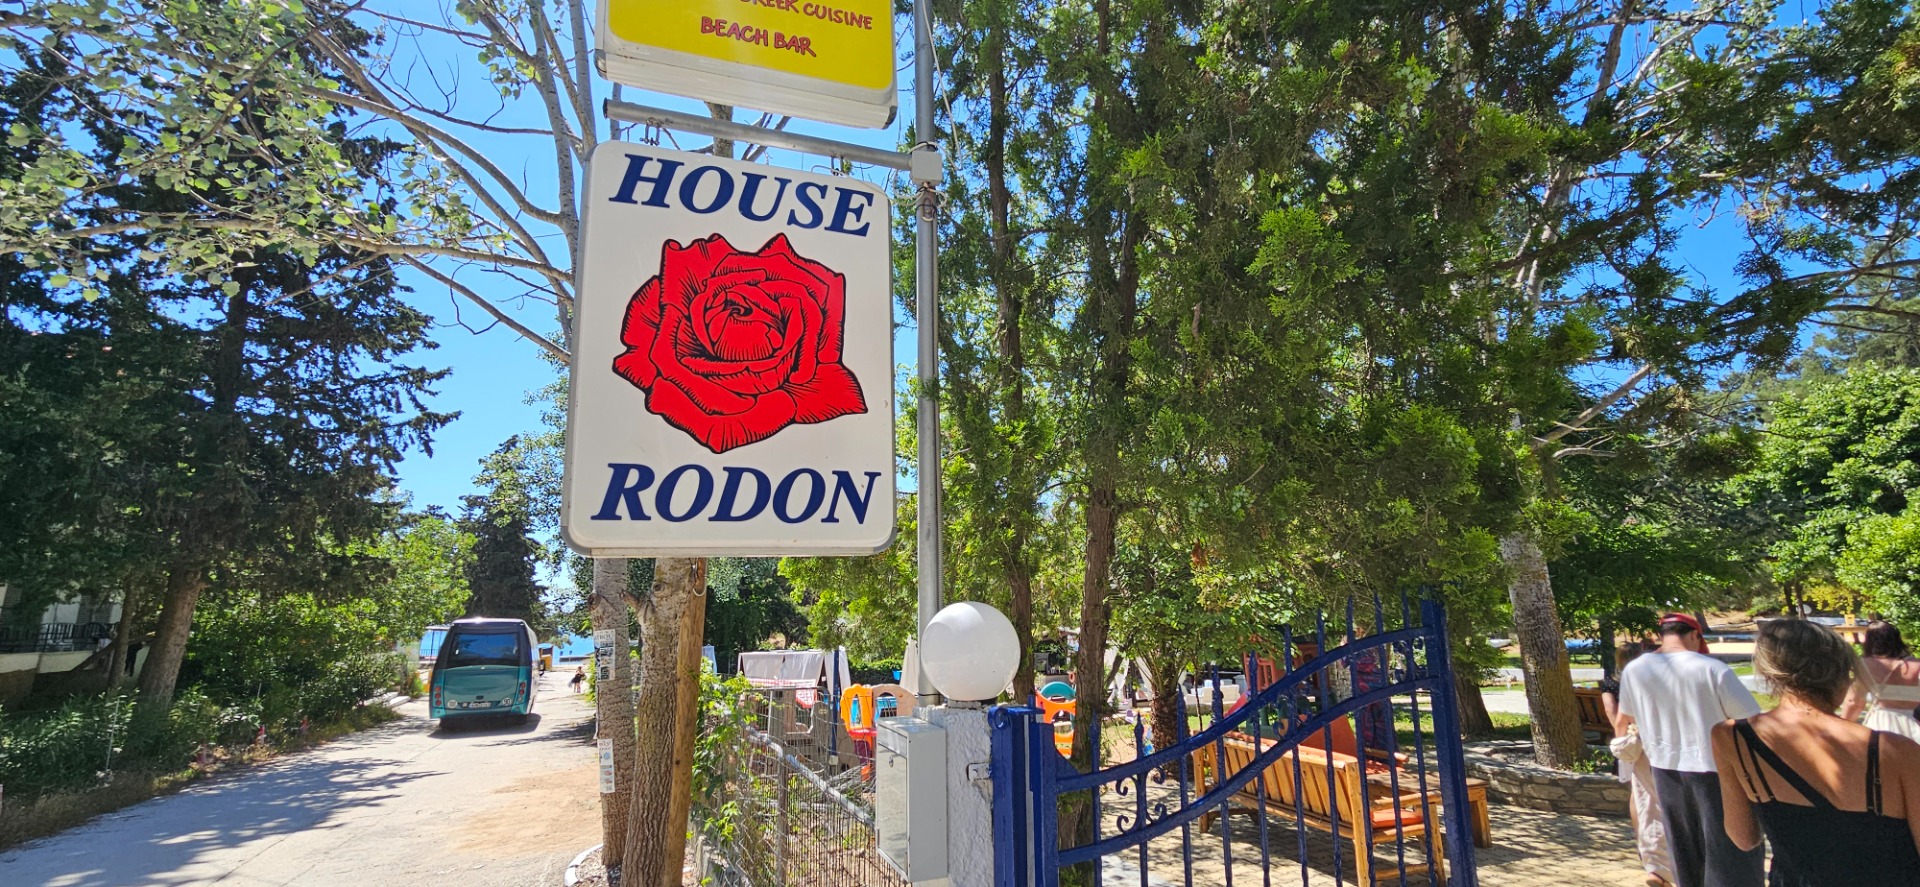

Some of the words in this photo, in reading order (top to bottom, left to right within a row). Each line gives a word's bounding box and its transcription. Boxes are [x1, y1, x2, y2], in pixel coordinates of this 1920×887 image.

[701, 16, 769, 47] BEACH
[774, 32, 817, 57] BAR
[802, 2, 873, 30] CUISINE
[608, 153, 874, 237] HOUSE
[590, 463, 882, 524] RODON
